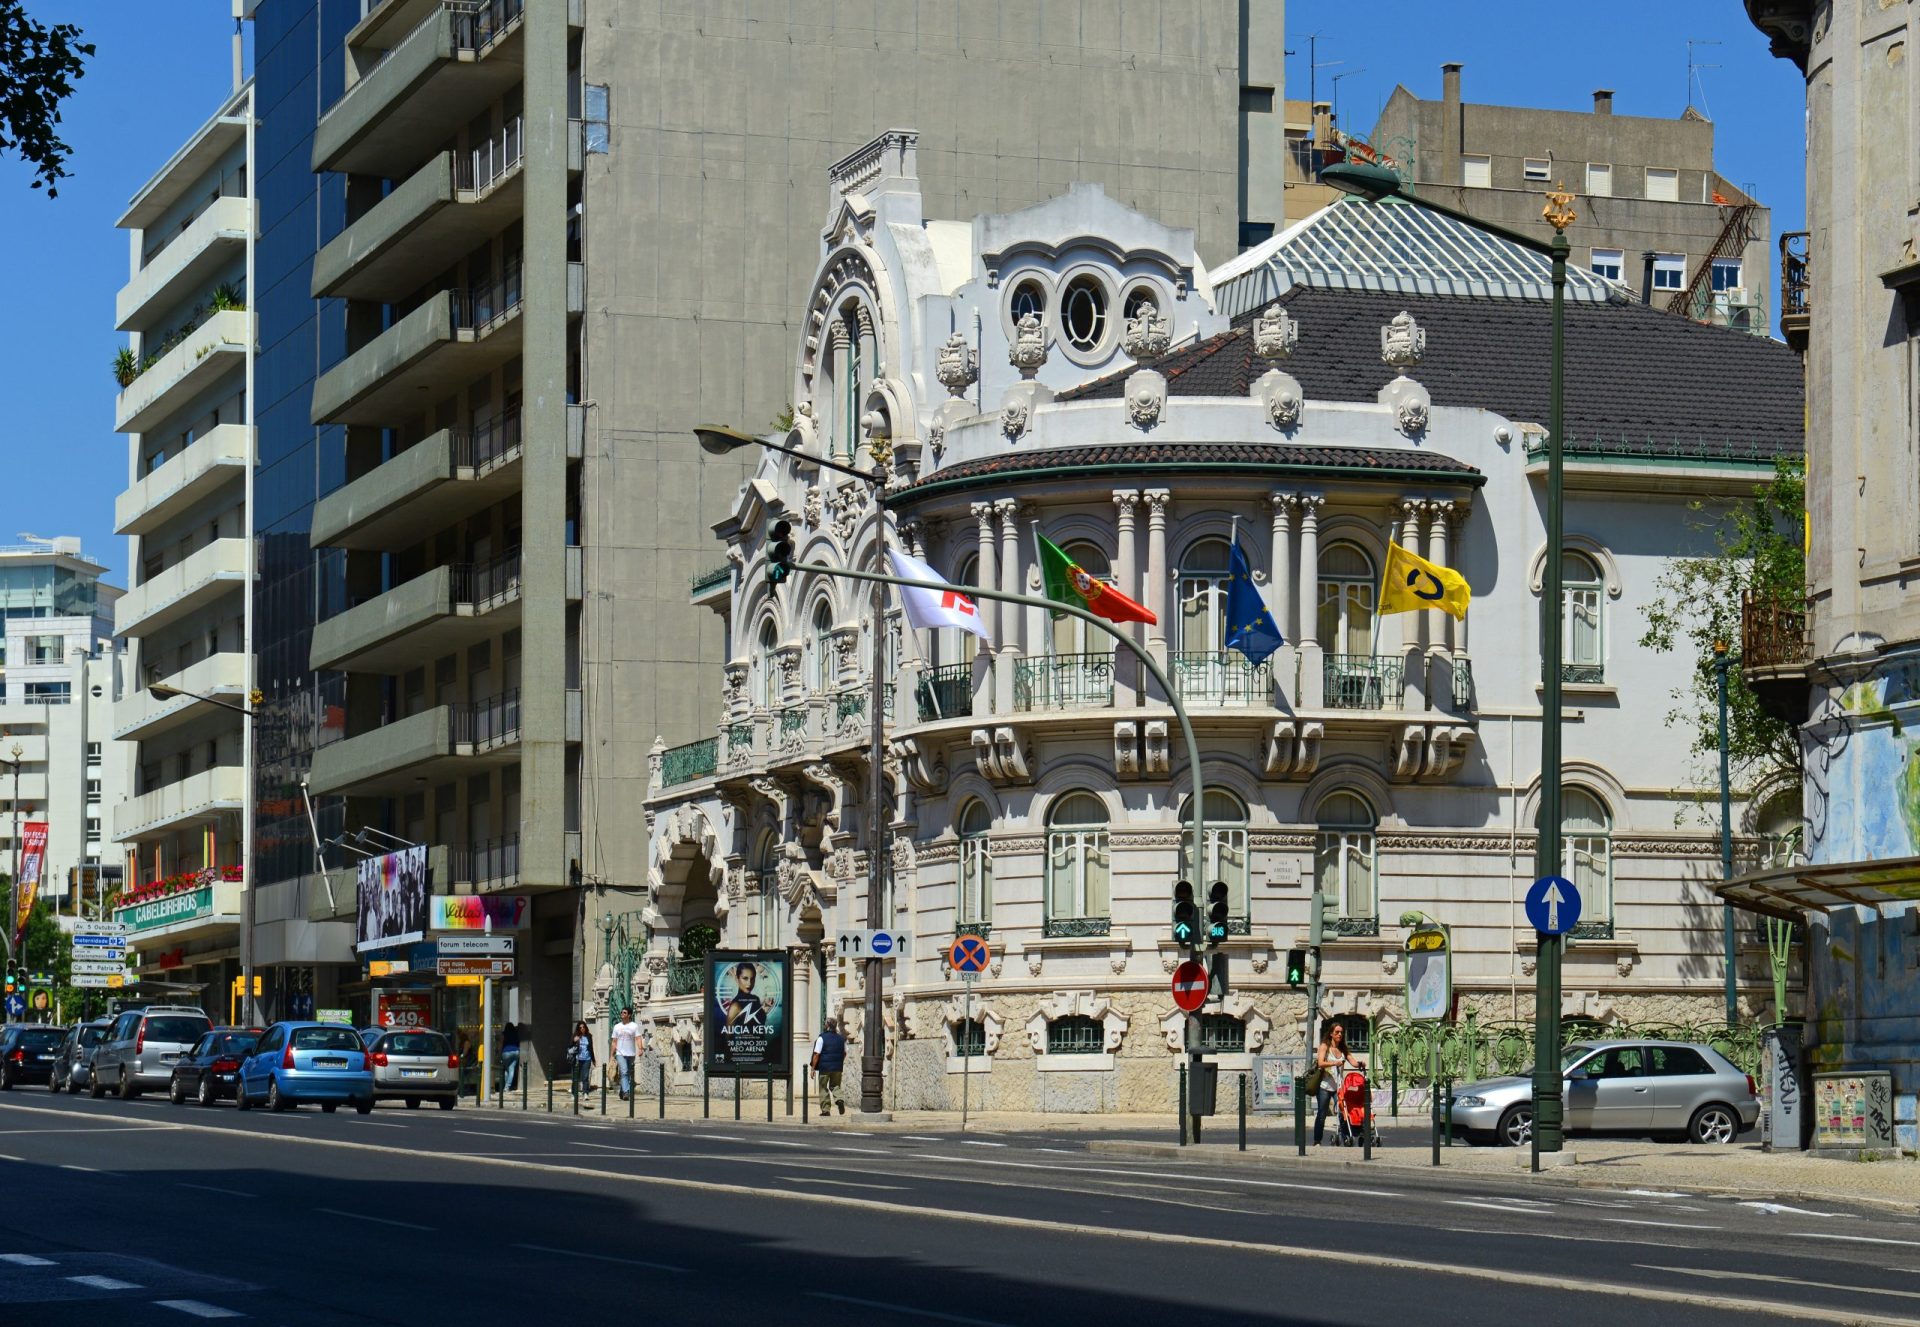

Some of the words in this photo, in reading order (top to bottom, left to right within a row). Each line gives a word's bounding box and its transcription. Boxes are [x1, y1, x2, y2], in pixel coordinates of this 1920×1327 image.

[136, 893, 197, 923] CABELEIREIROS
[1211, 926, 1224, 937] BUS
[721, 1025, 750, 1035] ALICIA
[752, 1025, 775, 1035] KEYS
